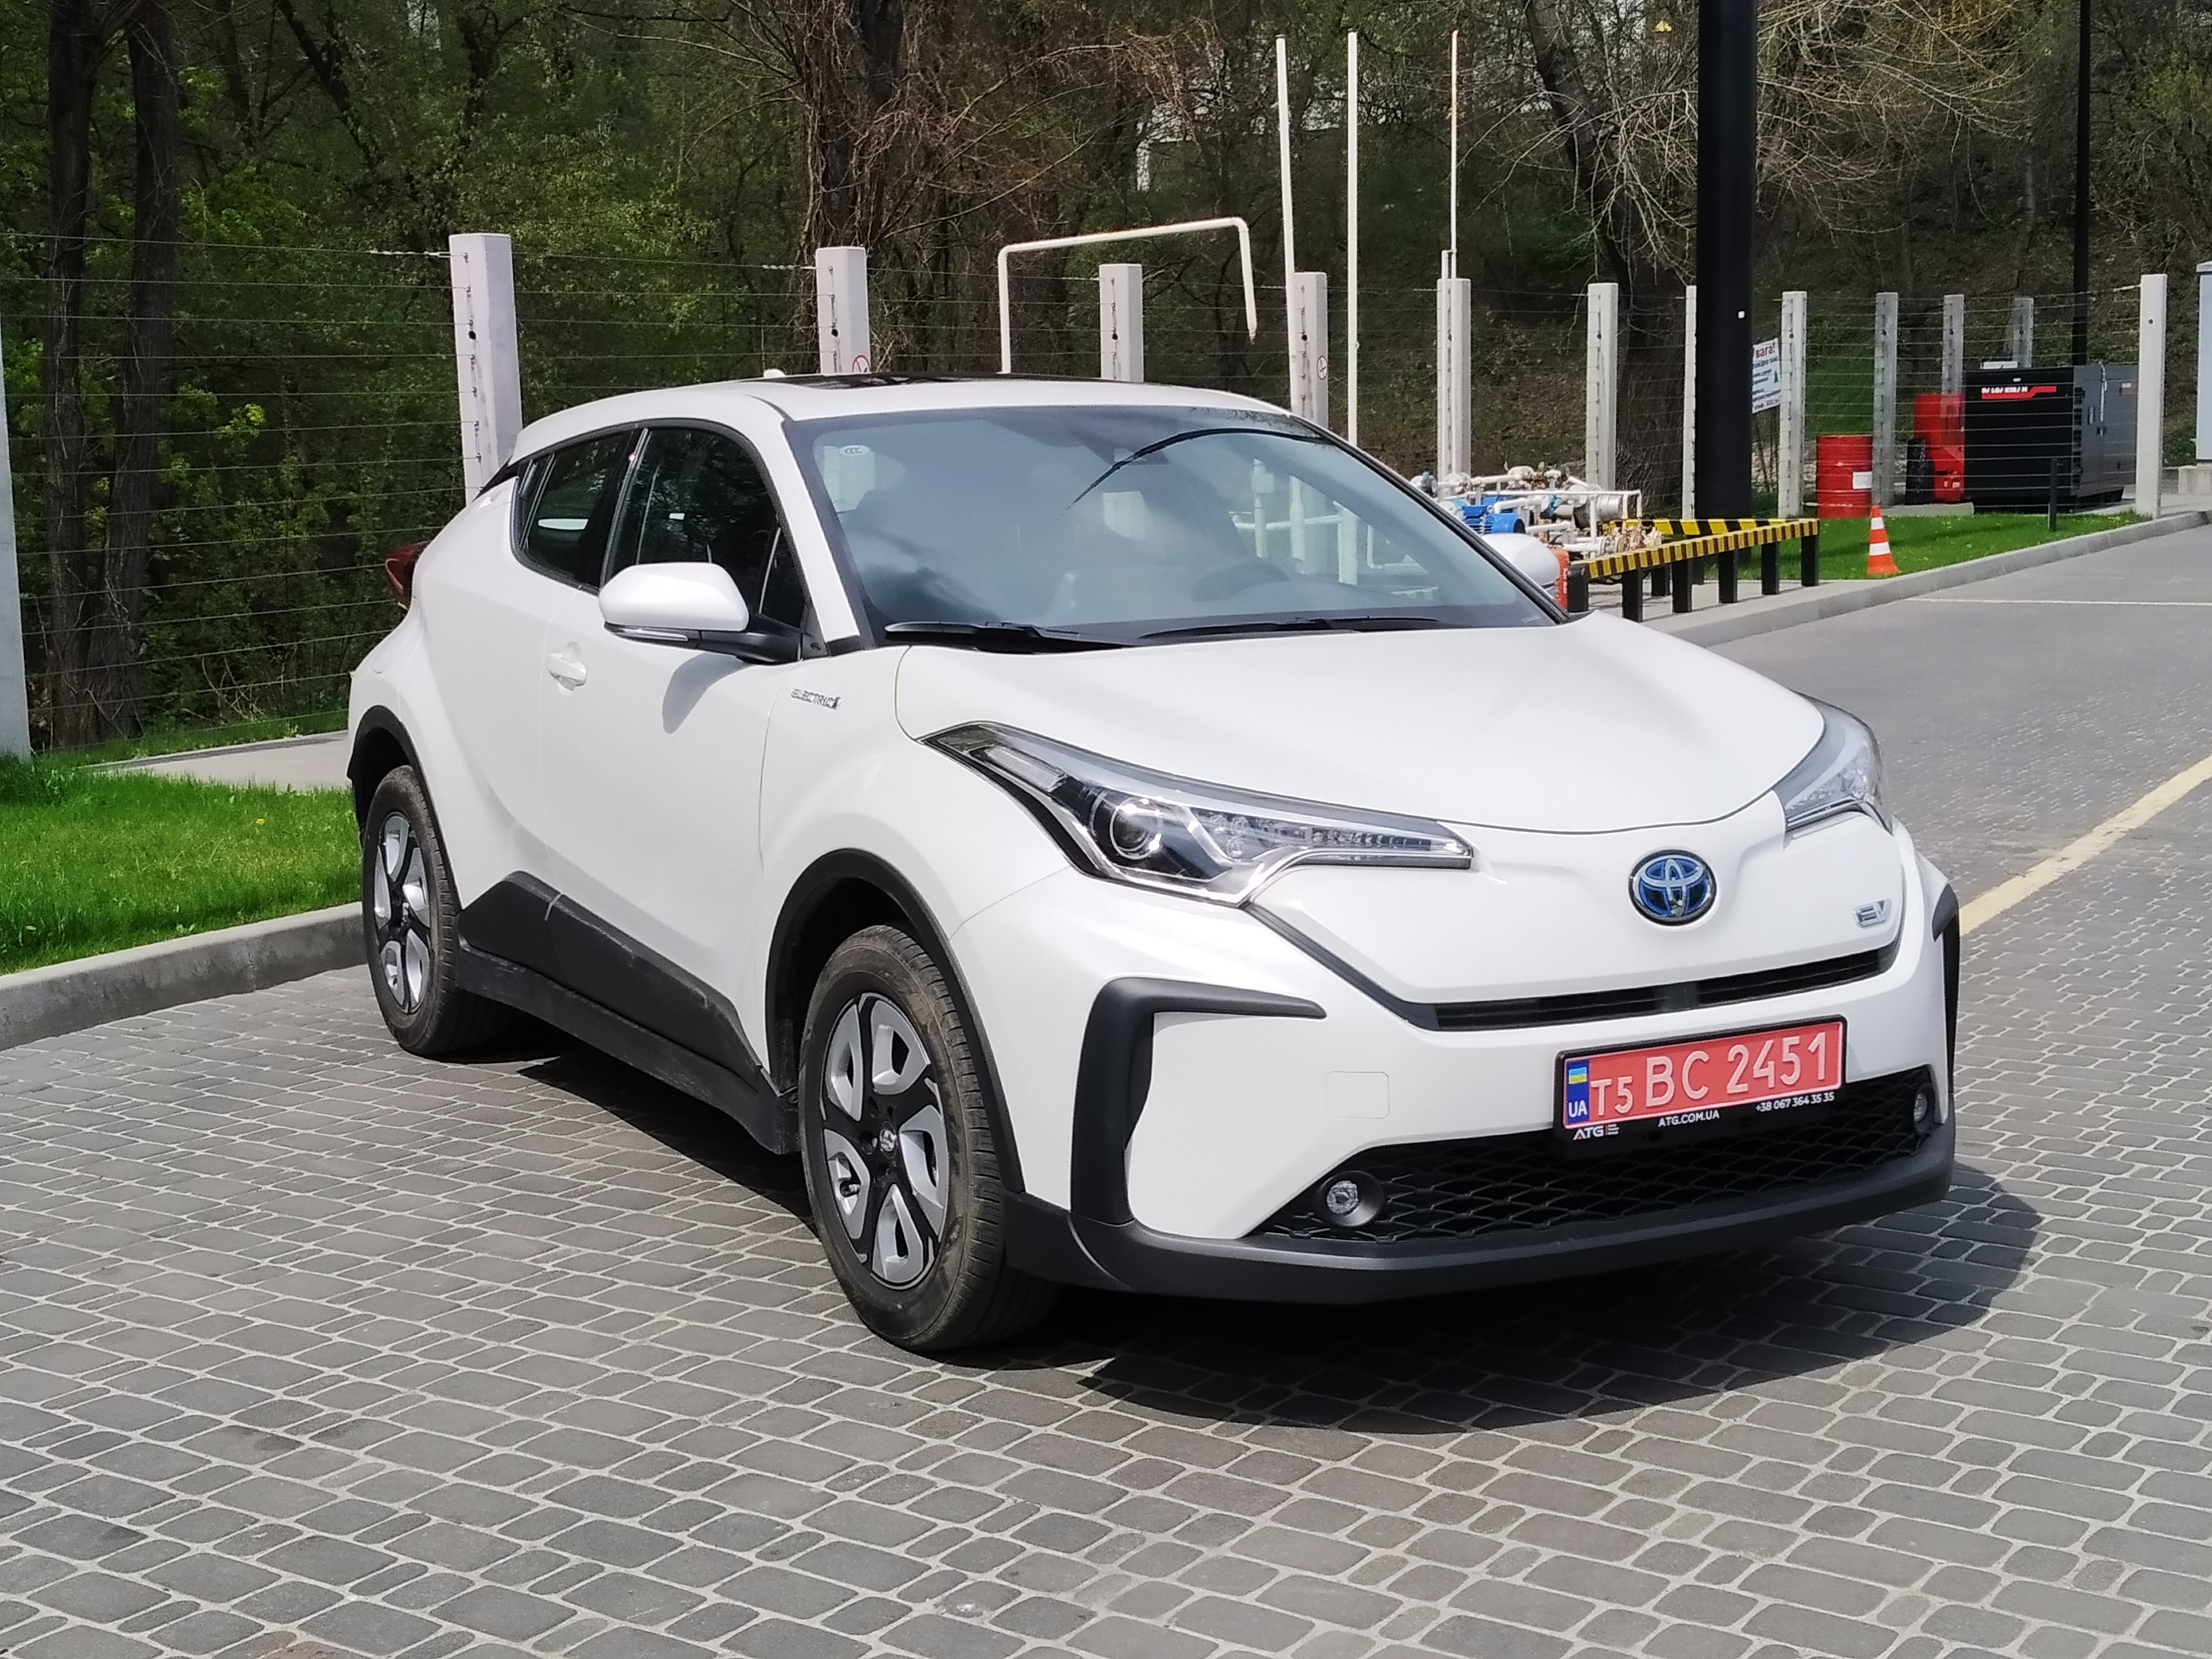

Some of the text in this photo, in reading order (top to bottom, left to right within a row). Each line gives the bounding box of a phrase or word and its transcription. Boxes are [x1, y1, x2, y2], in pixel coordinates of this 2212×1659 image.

[1590, 1032, 1825, 1115] T5 BC 2451
[1568, 1100, 1588, 1118] UA
[1756, 1092, 1835, 1112] +38 067 364 35 35
[1658, 1109, 1720, 1128] ATG.COM.UA
[1573, 1125, 1604, 1141] ATG
